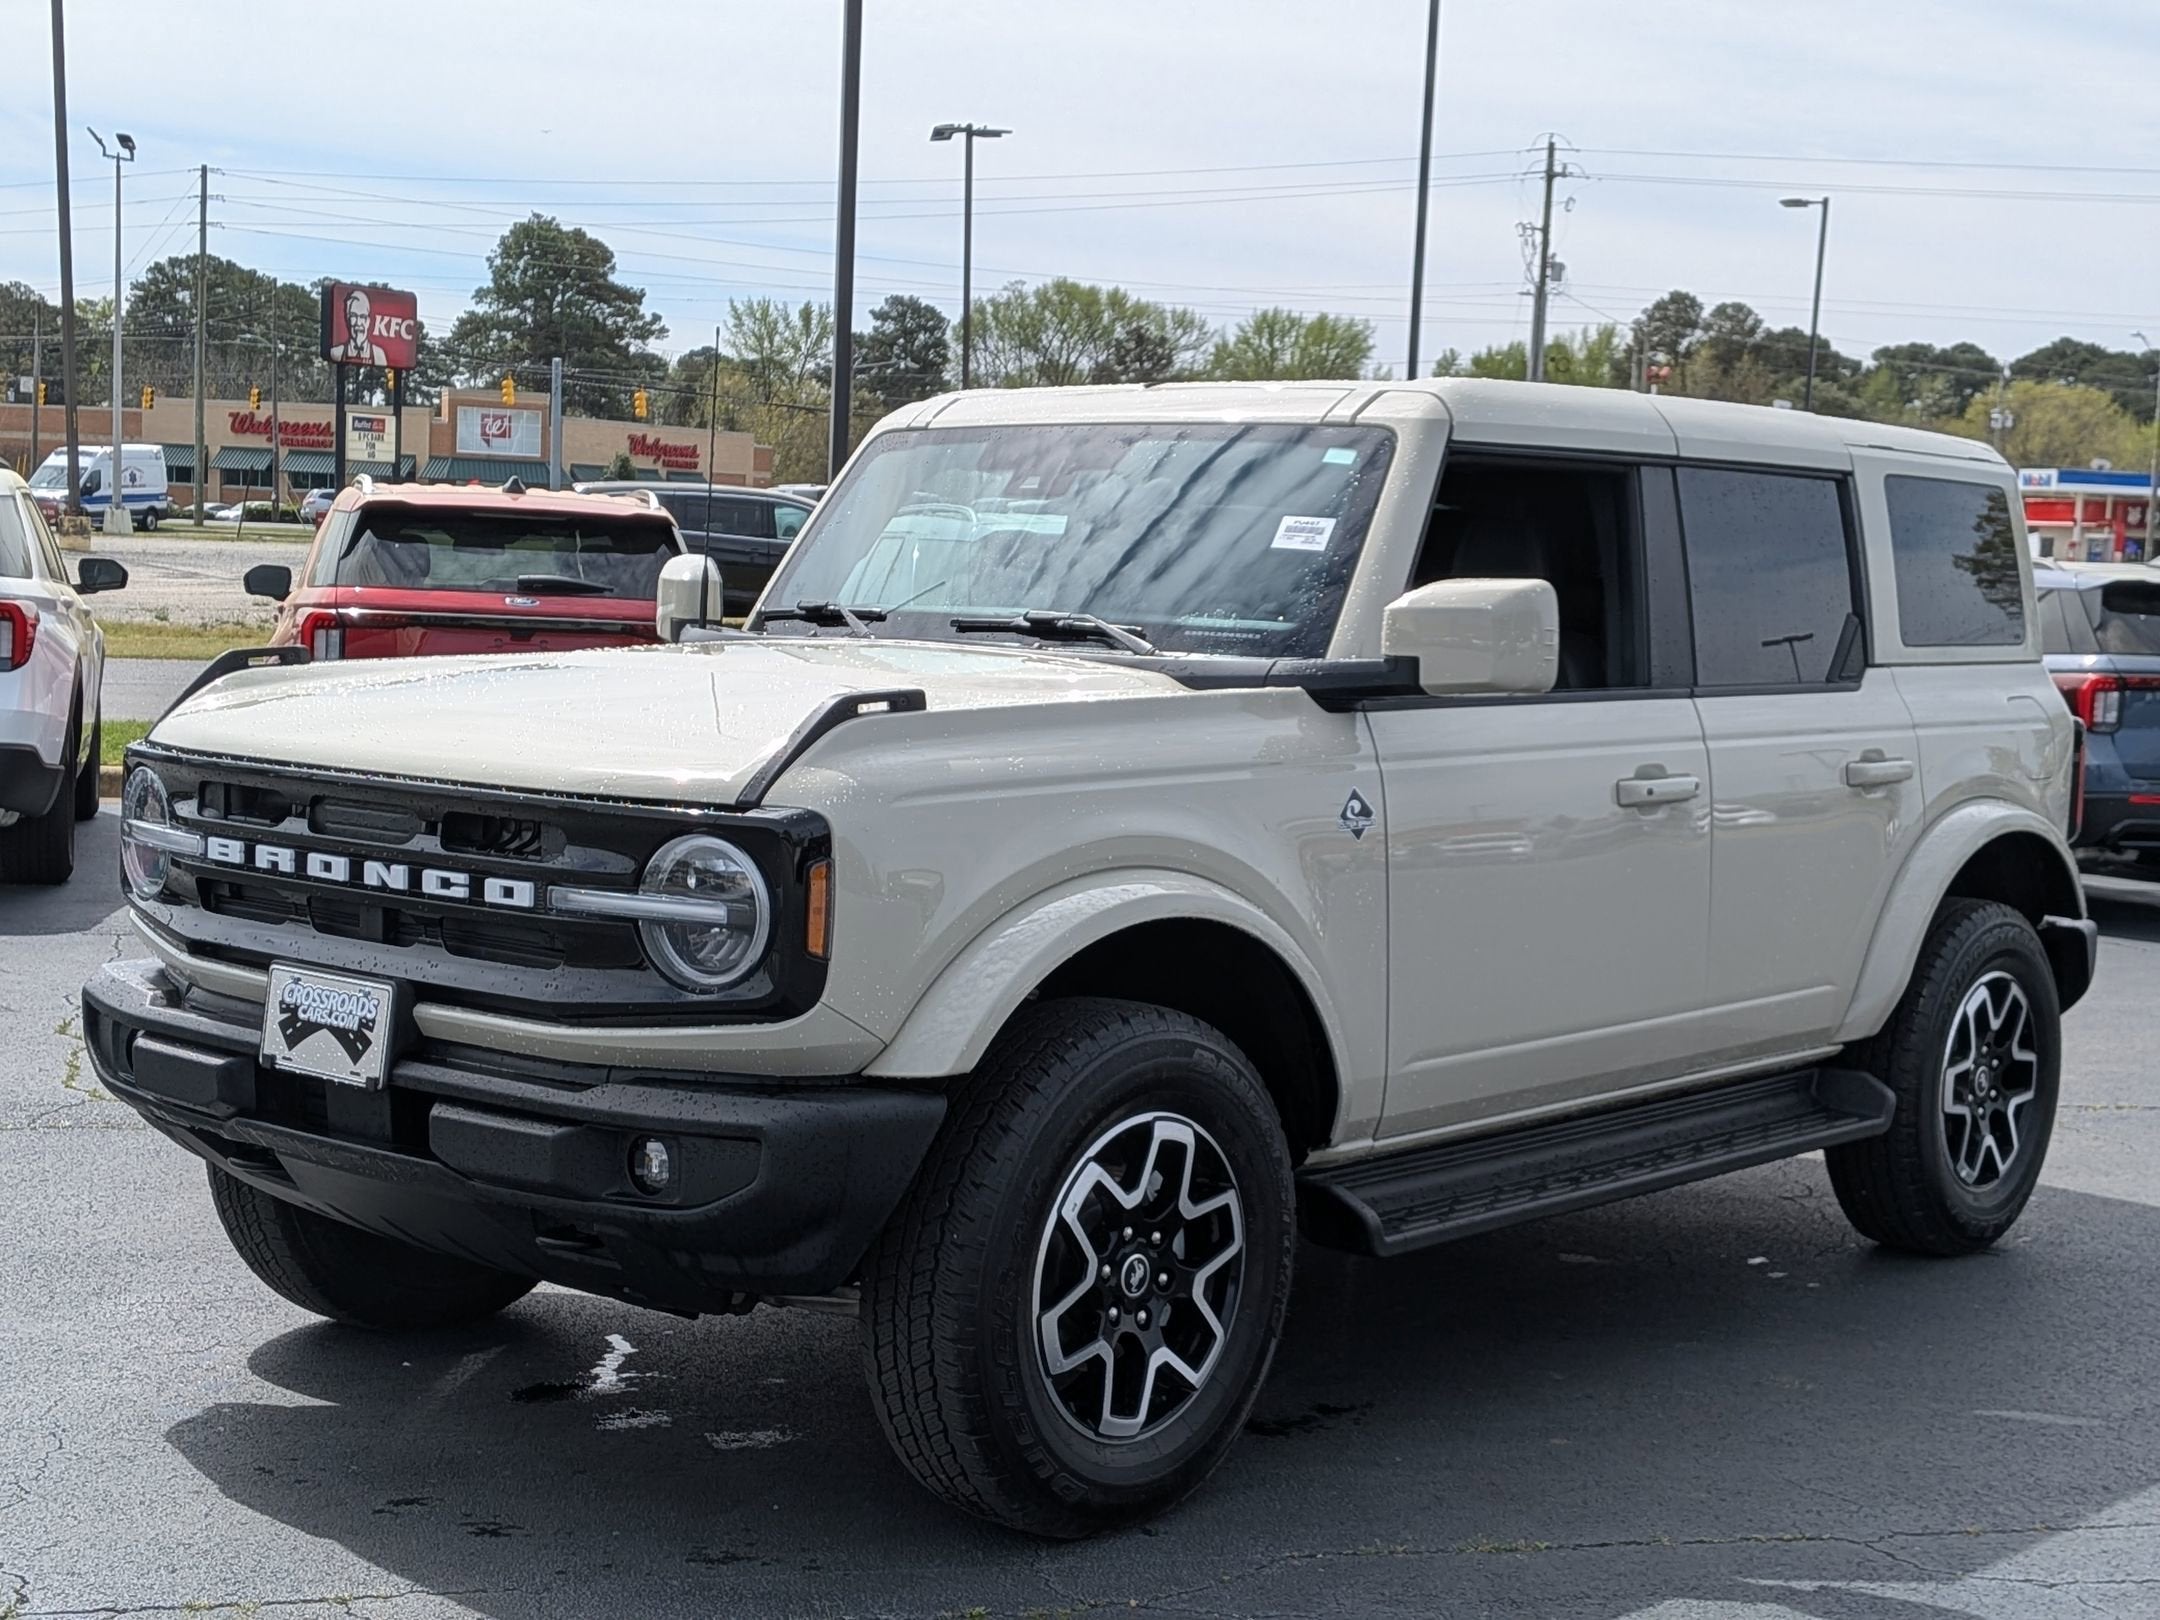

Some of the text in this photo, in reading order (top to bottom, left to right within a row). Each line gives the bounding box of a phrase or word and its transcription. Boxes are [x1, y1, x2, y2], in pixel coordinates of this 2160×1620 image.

[373, 314, 415, 341] KFC
[627, 433, 700, 464] Walgreens
[207, 836, 534, 907] BRONCO
[282, 983, 380, 1021] CROSSROADS
[298, 1004, 360, 1032] CARS.COM
